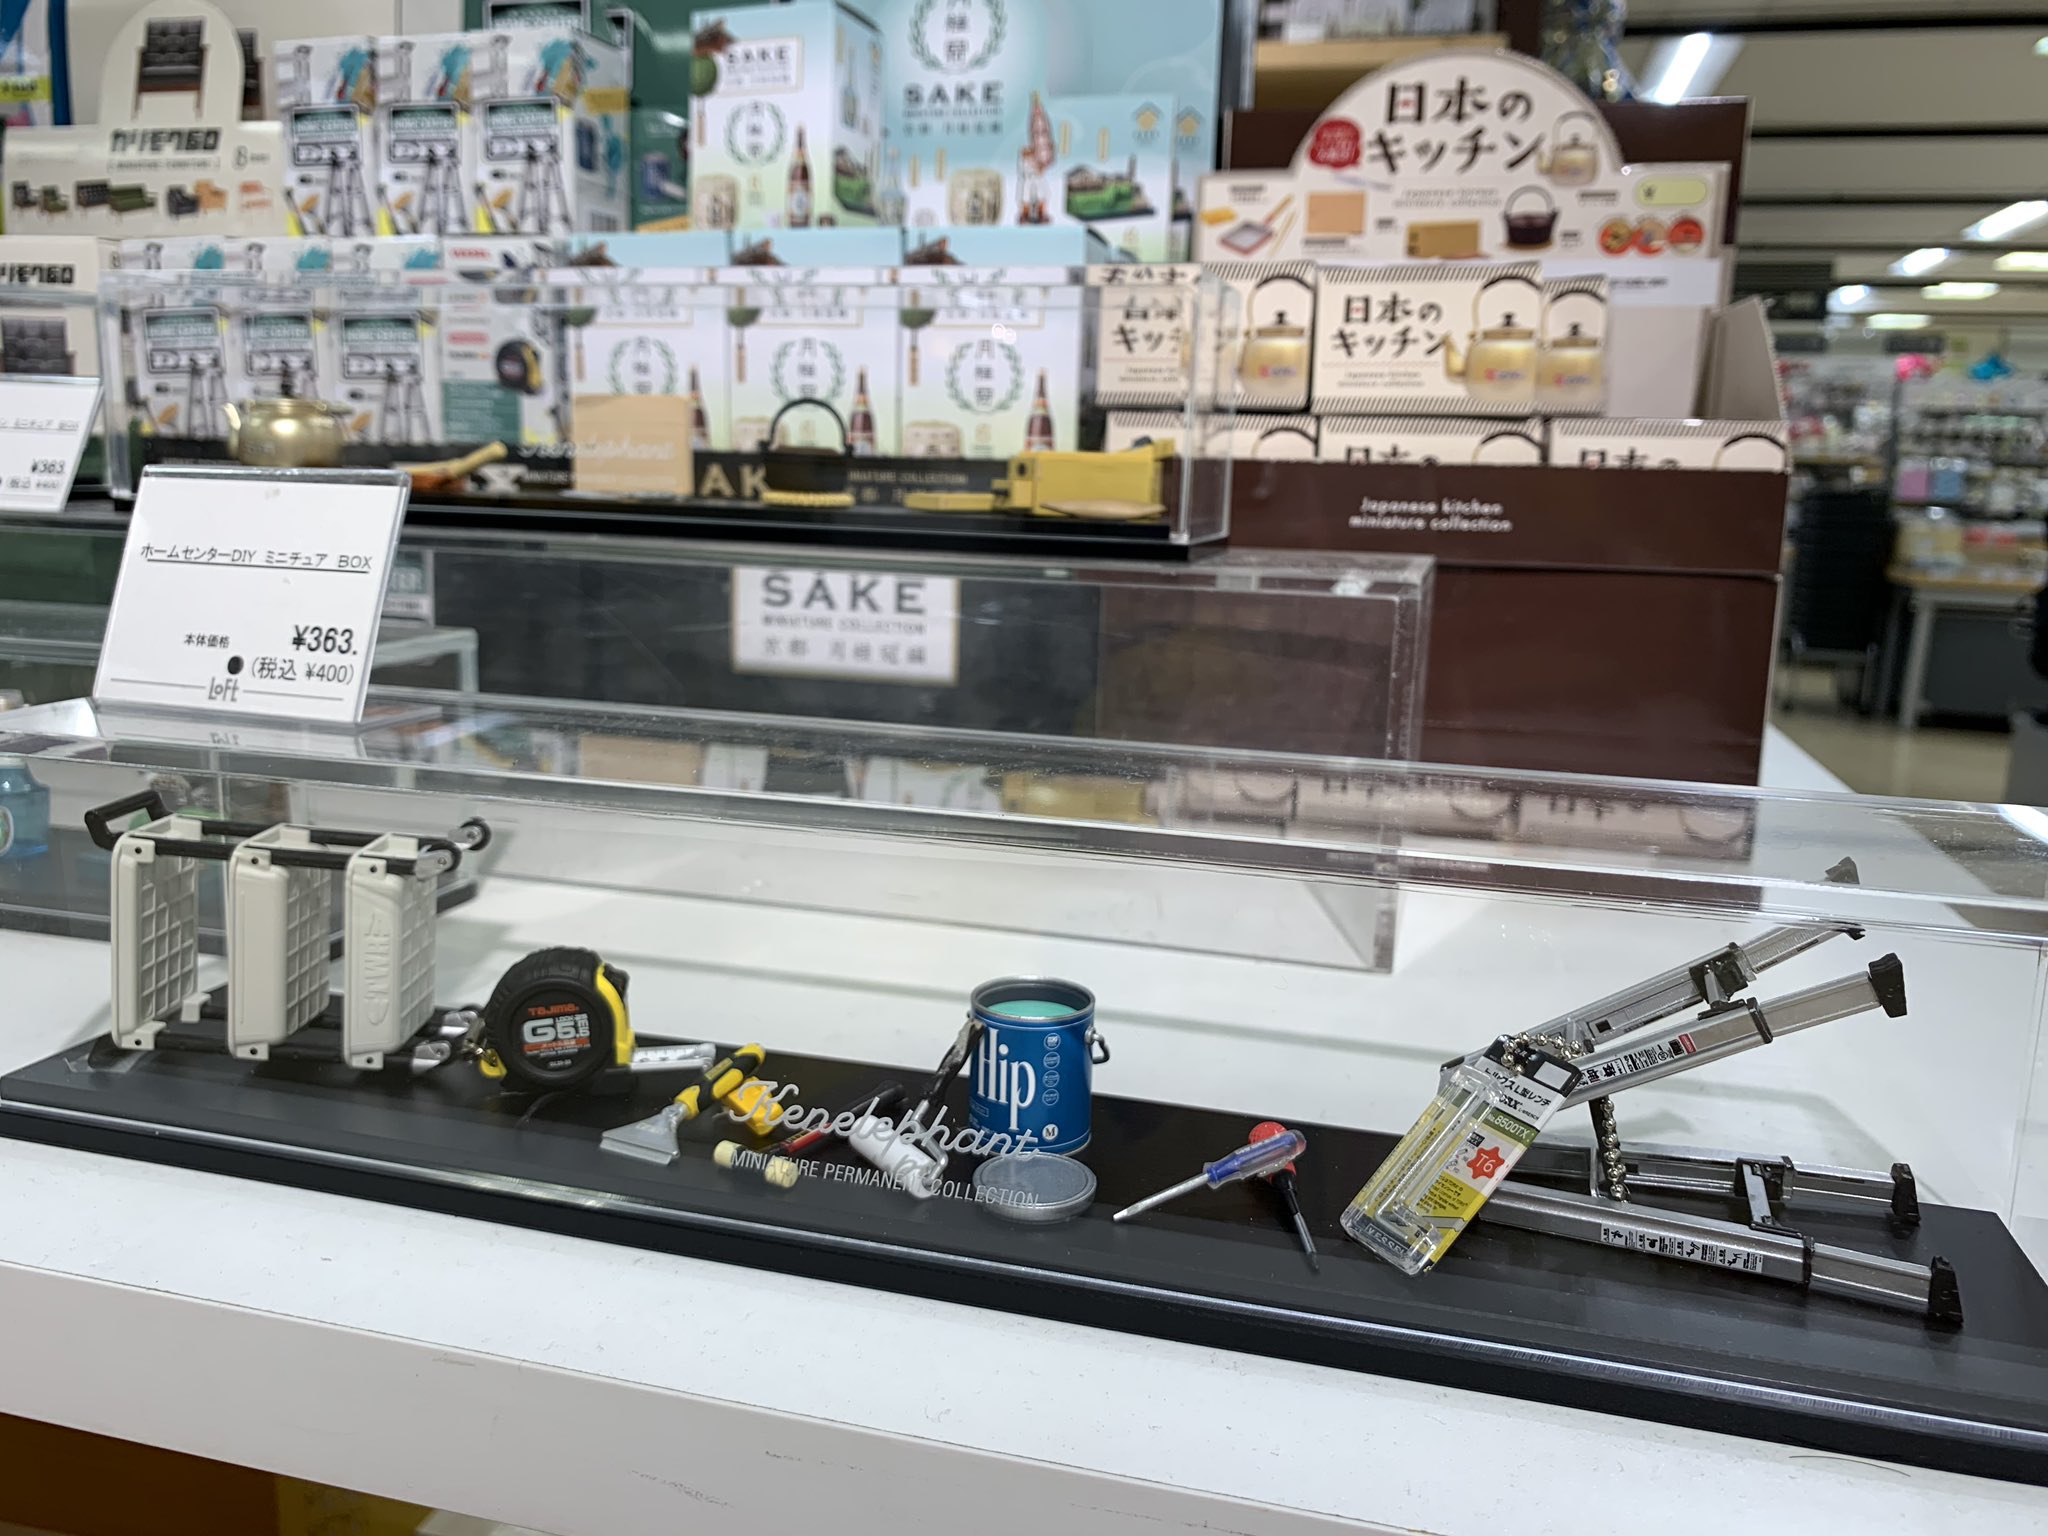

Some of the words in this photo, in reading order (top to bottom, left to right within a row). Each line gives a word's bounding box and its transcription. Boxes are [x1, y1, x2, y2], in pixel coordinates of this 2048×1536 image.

[902, 81, 1004, 107] SAKE
[1387, 77, 1534, 124] 日本の
[1369, 126, 1546, 173] キッチン
[1344, 291, 1443, 324] 日本の
[1331, 326, 1448, 358] キッチン
[1360, 496, 1438, 515] Japanese
[1442, 497, 1504, 515] kitchen
[1349, 513, 1426, 531] miniature
[1429, 515, 1513, 532] collection
[141, 544, 257, 563] ホームセンターDIY
[264, 550, 328, 566] ミニチュア
[338, 556, 372, 569] BOX
[762, 572, 926, 615] SAKE
[184, 634, 231, 649] 本体価格
[251, 656, 297, 681] (税込
[305, 662, 354, 685] ¥400)
[976, 1025, 1036, 1132] Hip
[1045, 1128, 1056, 1137] M
[1479, 1153, 1494, 1173] T6
[930, 1178, 1040, 1208] COLLECTION
